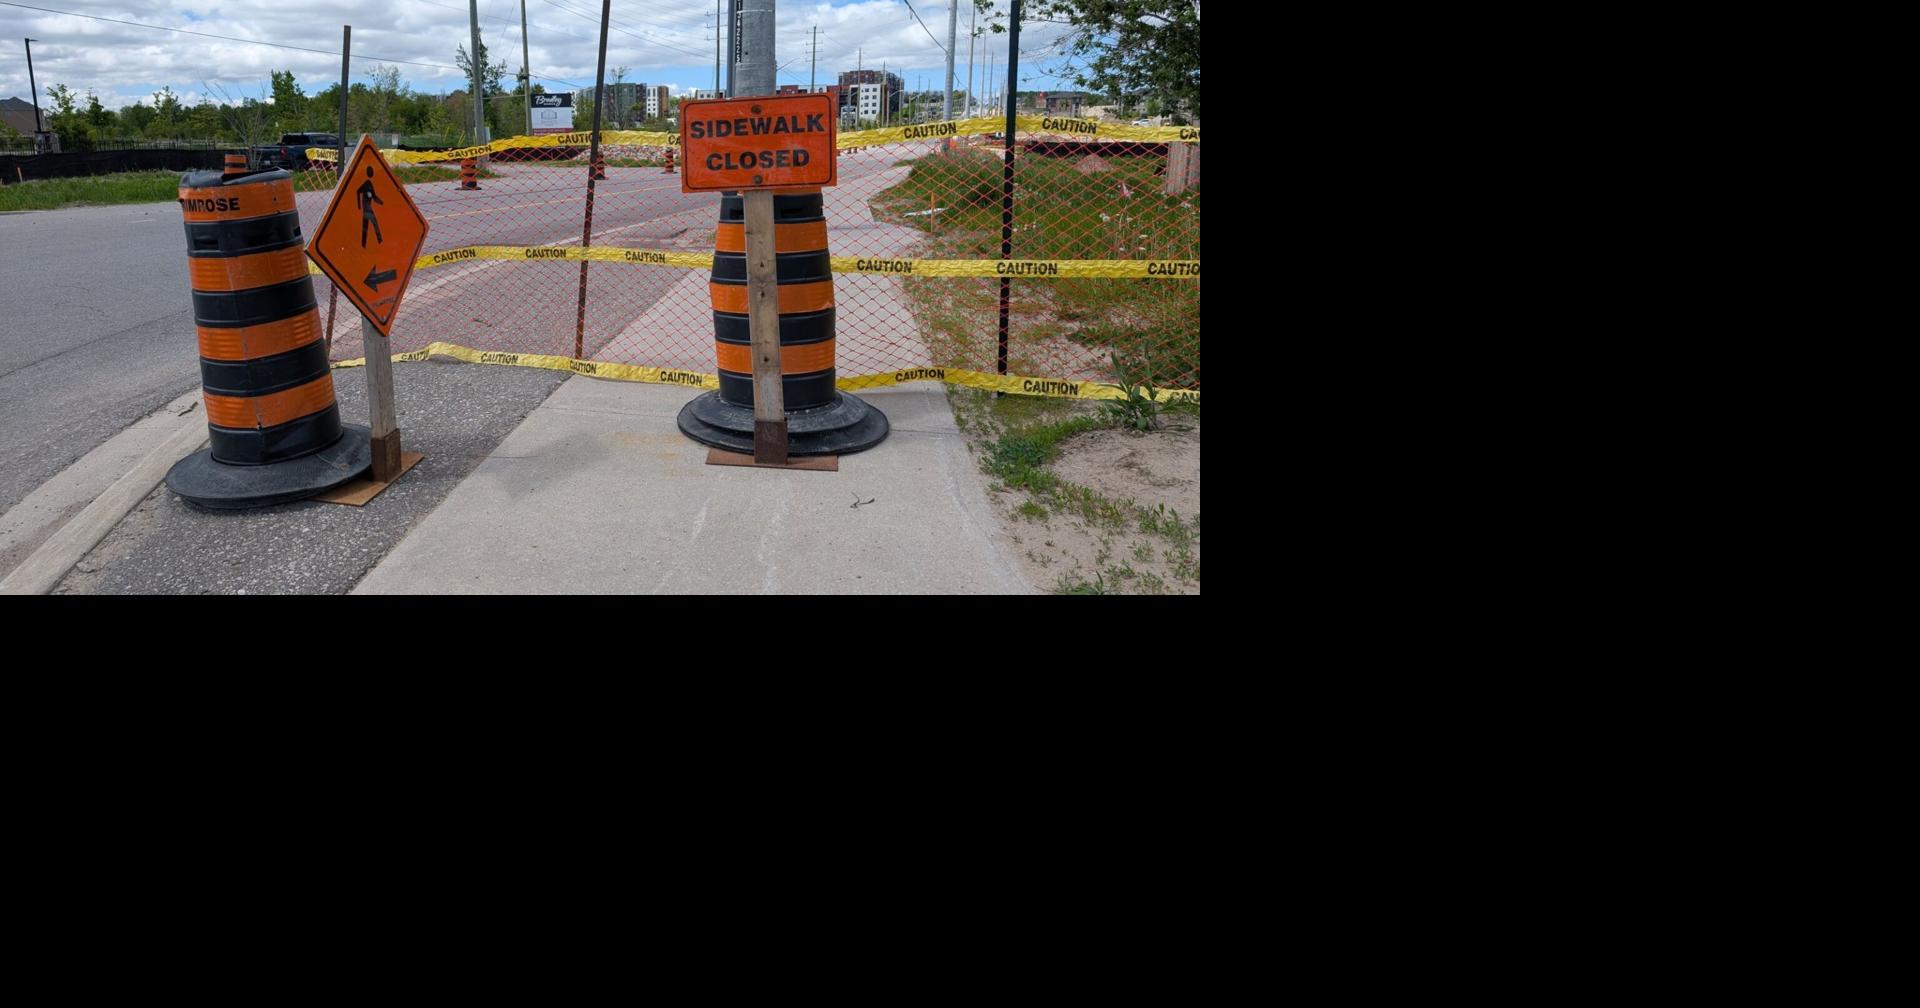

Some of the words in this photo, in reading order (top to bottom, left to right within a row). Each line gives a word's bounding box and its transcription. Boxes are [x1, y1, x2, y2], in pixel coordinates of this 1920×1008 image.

[690, 114, 825, 139] SIDEWALK
[904, 122, 957, 139] CAUTION
[1042, 118, 1097, 135] CAUTION
[448, 145, 492, 158] CAUTION
[706, 149, 810, 171] CLOSED
[433, 249, 476, 263] CAUTION
[525, 249, 567, 258] CAUTION
[625, 251, 666, 263] CAUTION
[856, 259, 912, 273] CAUTION
[997, 262, 1058, 275] CAUTION
[1148, 262, 1200, 275] CAUTIO
[480, 353, 518, 365] CAUTION
[569, 360, 597, 374] CAUTION
[660, 371, 703, 386] CAUTION
[895, 368, 945, 382] CAUTION
[1023, 380, 1079, 396] CAUTION
